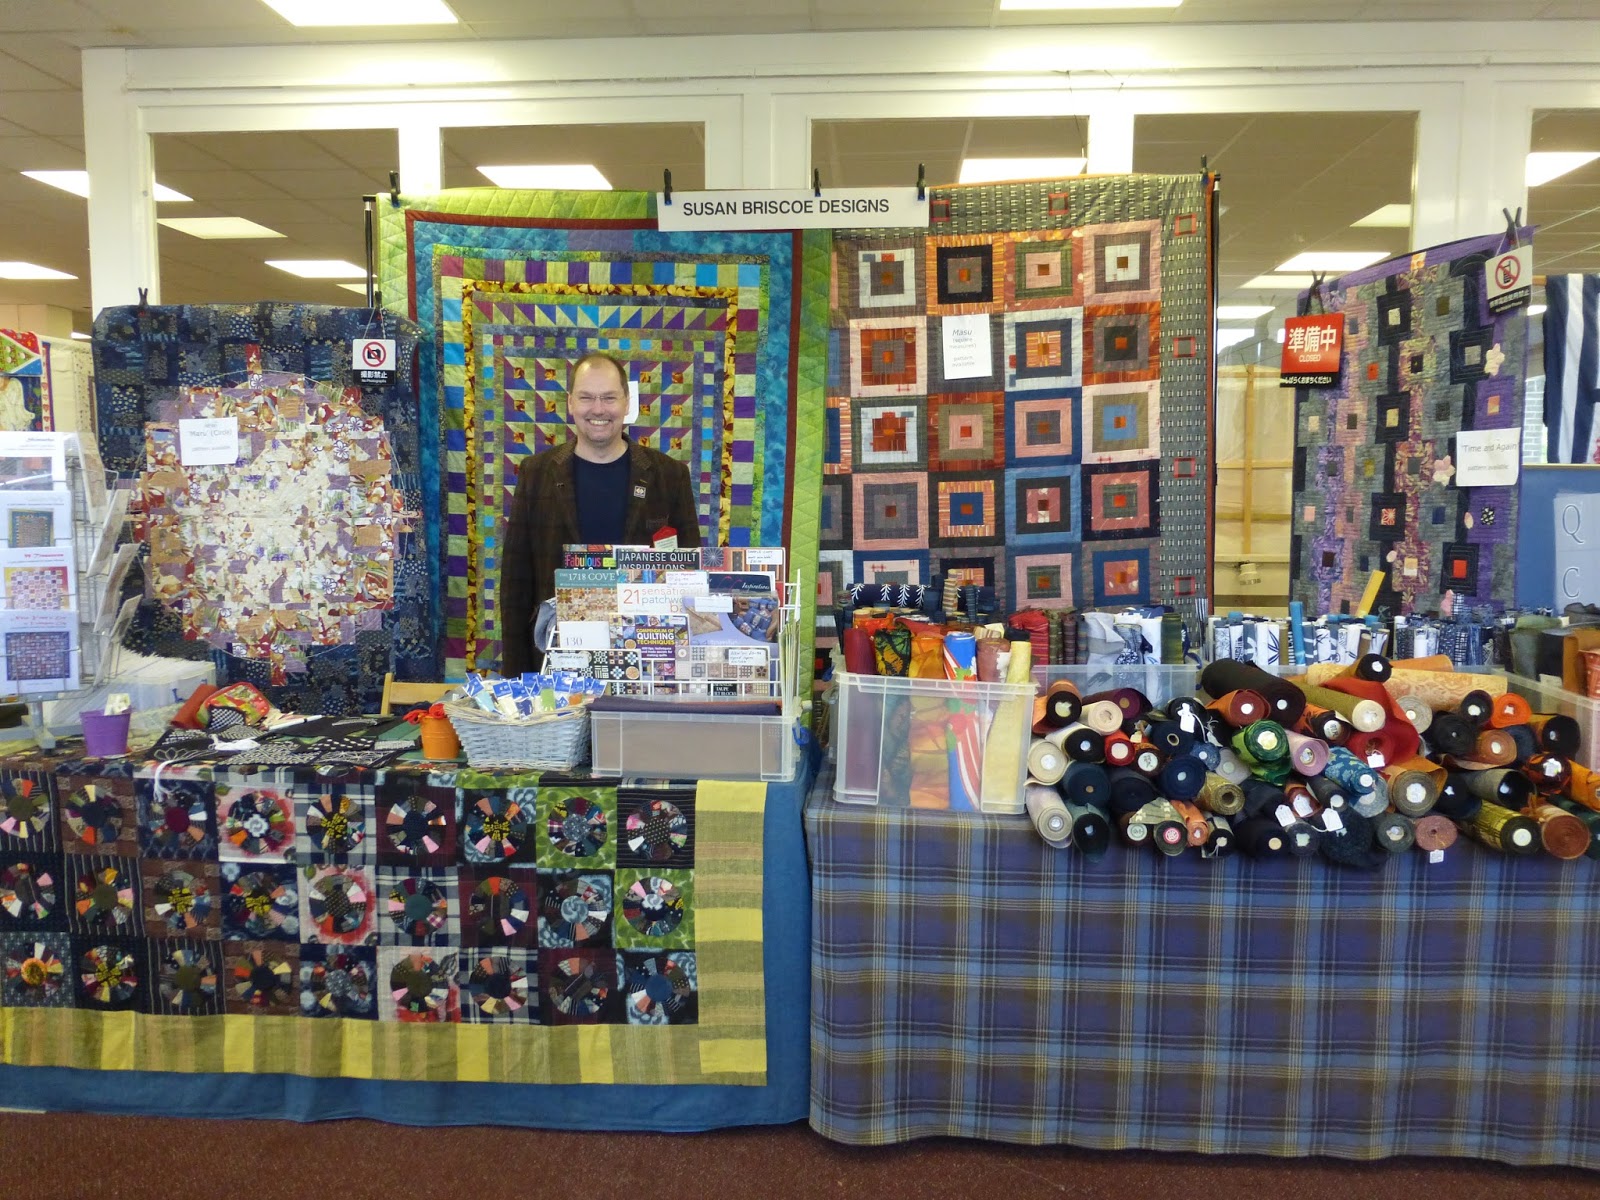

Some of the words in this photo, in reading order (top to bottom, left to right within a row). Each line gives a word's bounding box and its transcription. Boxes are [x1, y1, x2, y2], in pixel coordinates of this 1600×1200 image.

[683, 201, 737, 216] SUSAN
[742, 200, 814, 215] BRISCOE
[819, 199, 890, 214] DESIGNS
[1287, 325, 1337, 353] 準備中
[1299, 354, 1321, 363] CLOSED
[1483, 444, 1495, 452] and
[1562, 504, 1584, 544] Q
[565, 554, 601, 567] Fabulous
[619, 553, 667, 562] JAPANESE
[670, 552, 697, 562] QUILT
[568, 572, 586, 581] 1718
[1562, 567, 1580, 598] C
[623, 589, 640, 605] 21
